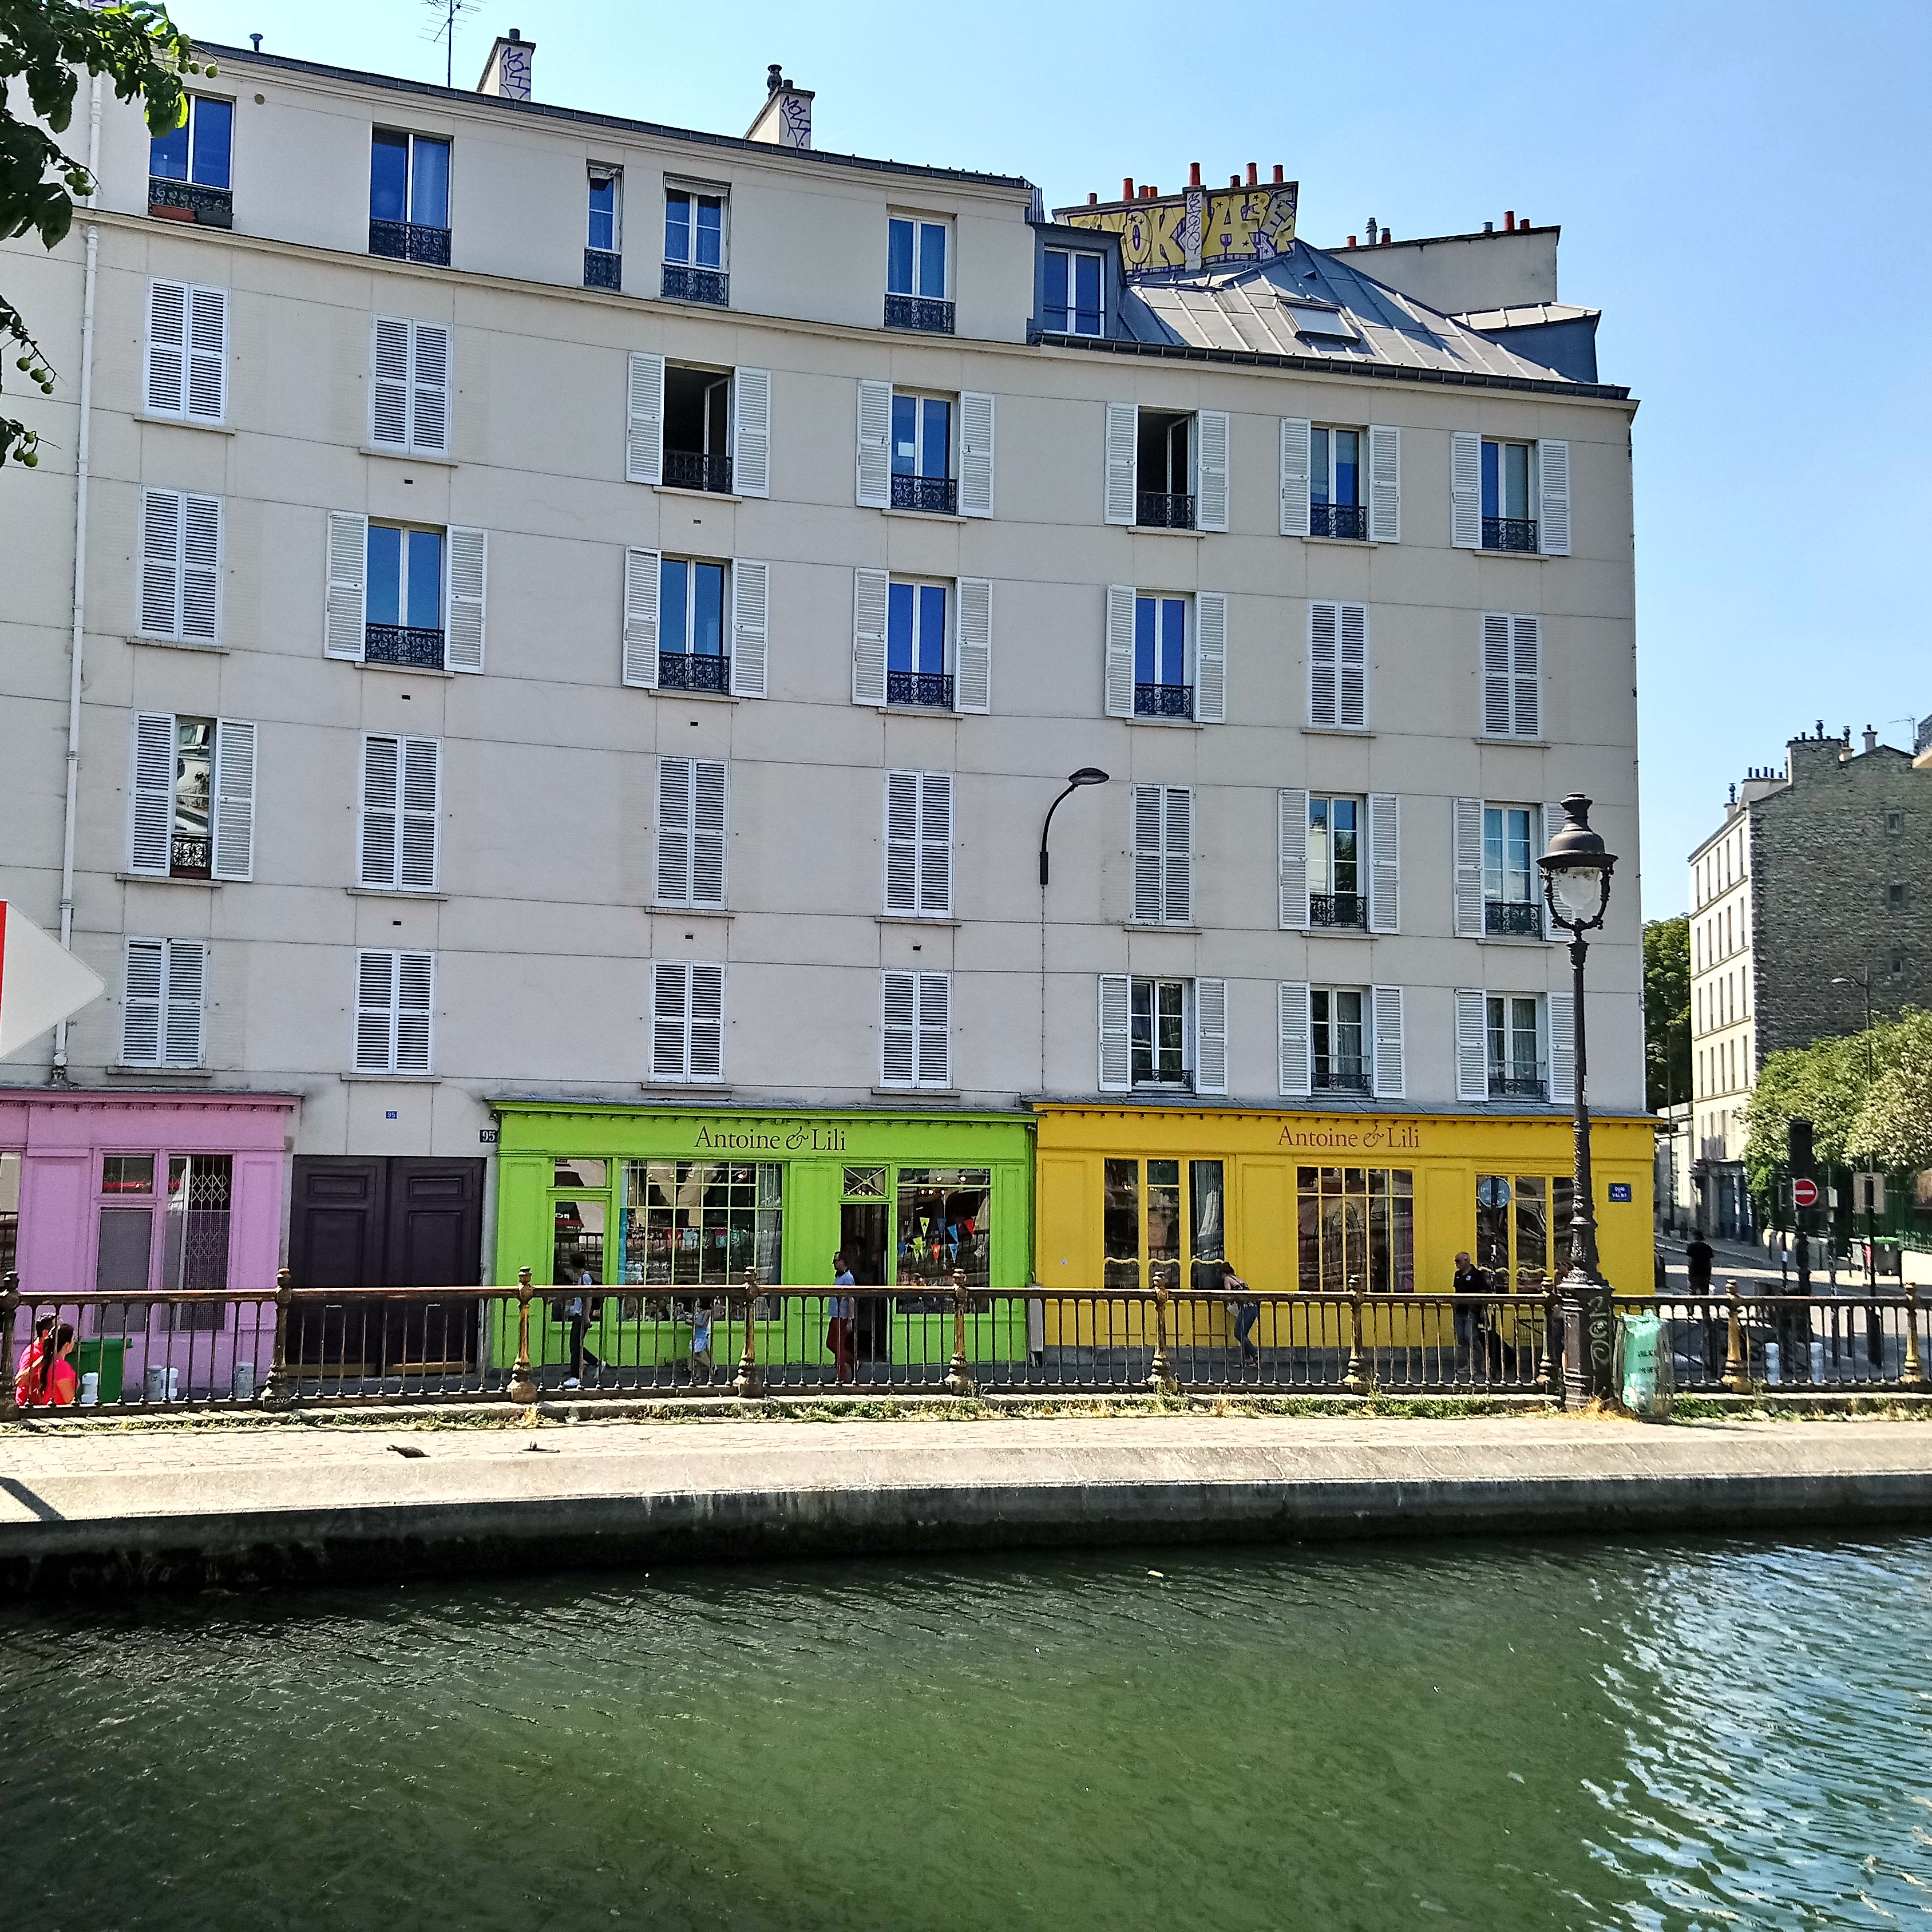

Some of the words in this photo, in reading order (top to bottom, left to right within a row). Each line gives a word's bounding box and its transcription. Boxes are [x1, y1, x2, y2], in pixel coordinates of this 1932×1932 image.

[482, 1130, 496, 1142] 95
[694, 1126, 781, 1149] Antoine
[786, 1126, 809, 1150] &
[811, 1128, 846, 1151] Lili
[1277, 1125, 1359, 1147] Antoine
[1363, 1123, 1384, 1148] &
[1386, 1126, 1421, 1149] Lili
